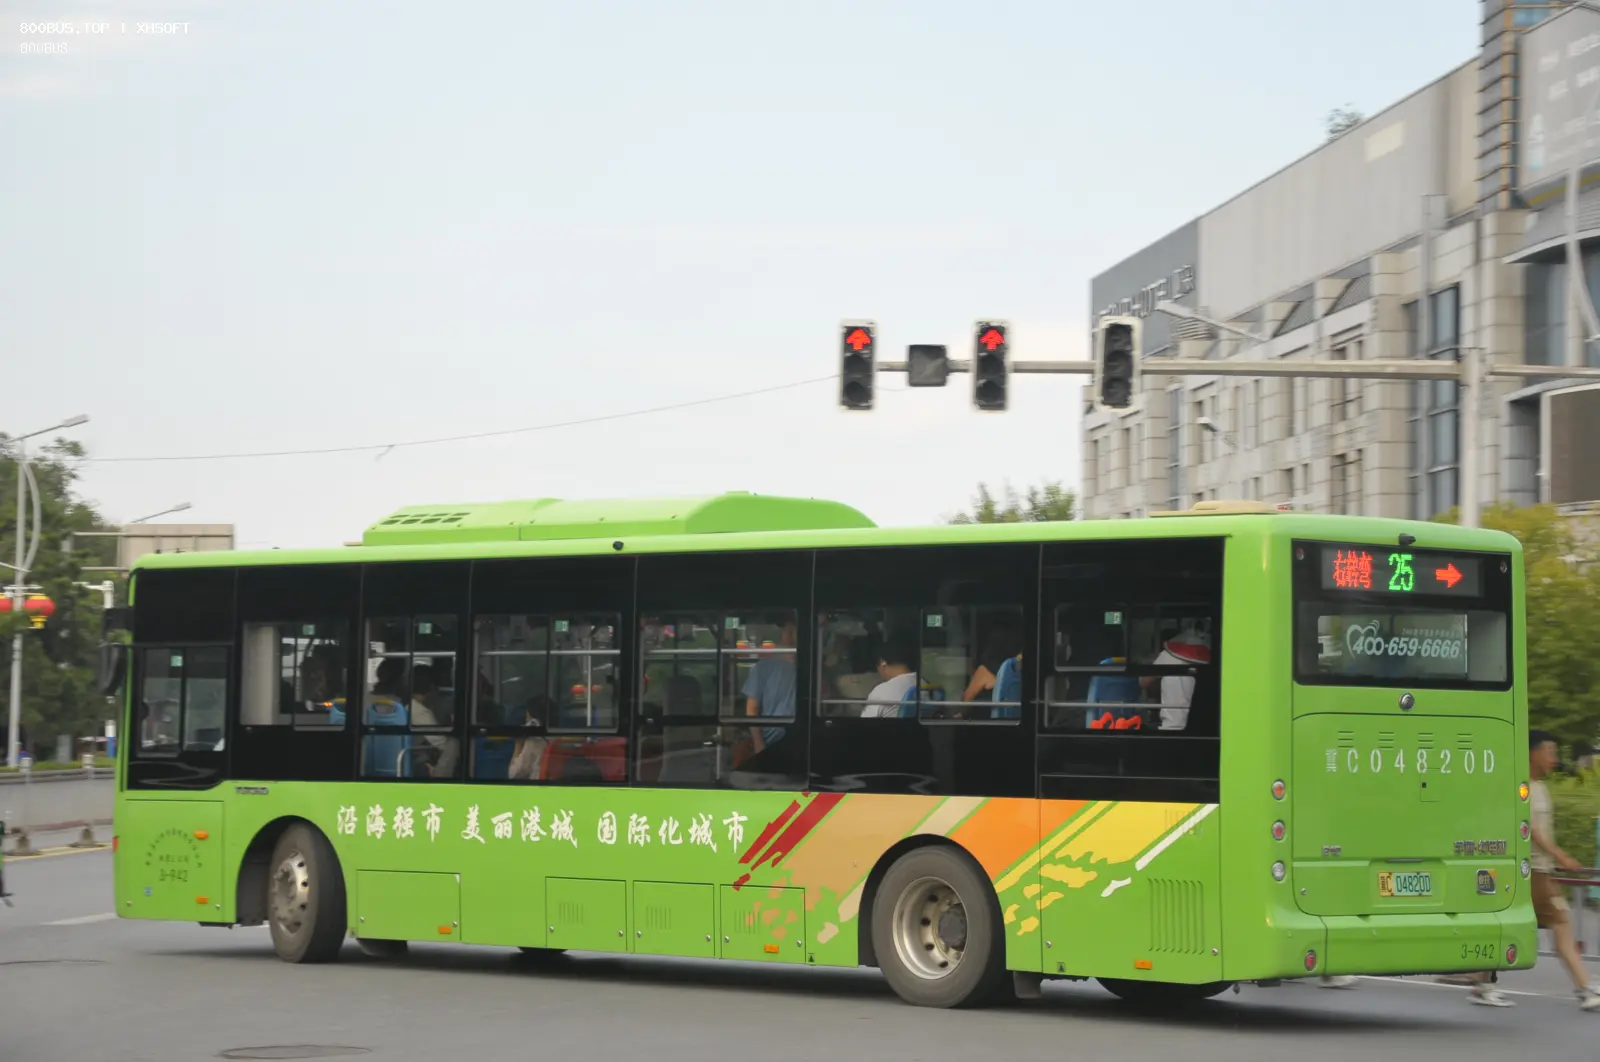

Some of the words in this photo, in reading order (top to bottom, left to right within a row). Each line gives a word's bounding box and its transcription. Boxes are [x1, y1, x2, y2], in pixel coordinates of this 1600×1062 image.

[1388, 553, 1414, 592] 25
[336, 802, 445, 843] 沿海强市
[460, 804, 578, 849] 美丽港城
[596, 810, 750, 854] 国际化城市
[1460, 943, 1495, 960] 3-942
